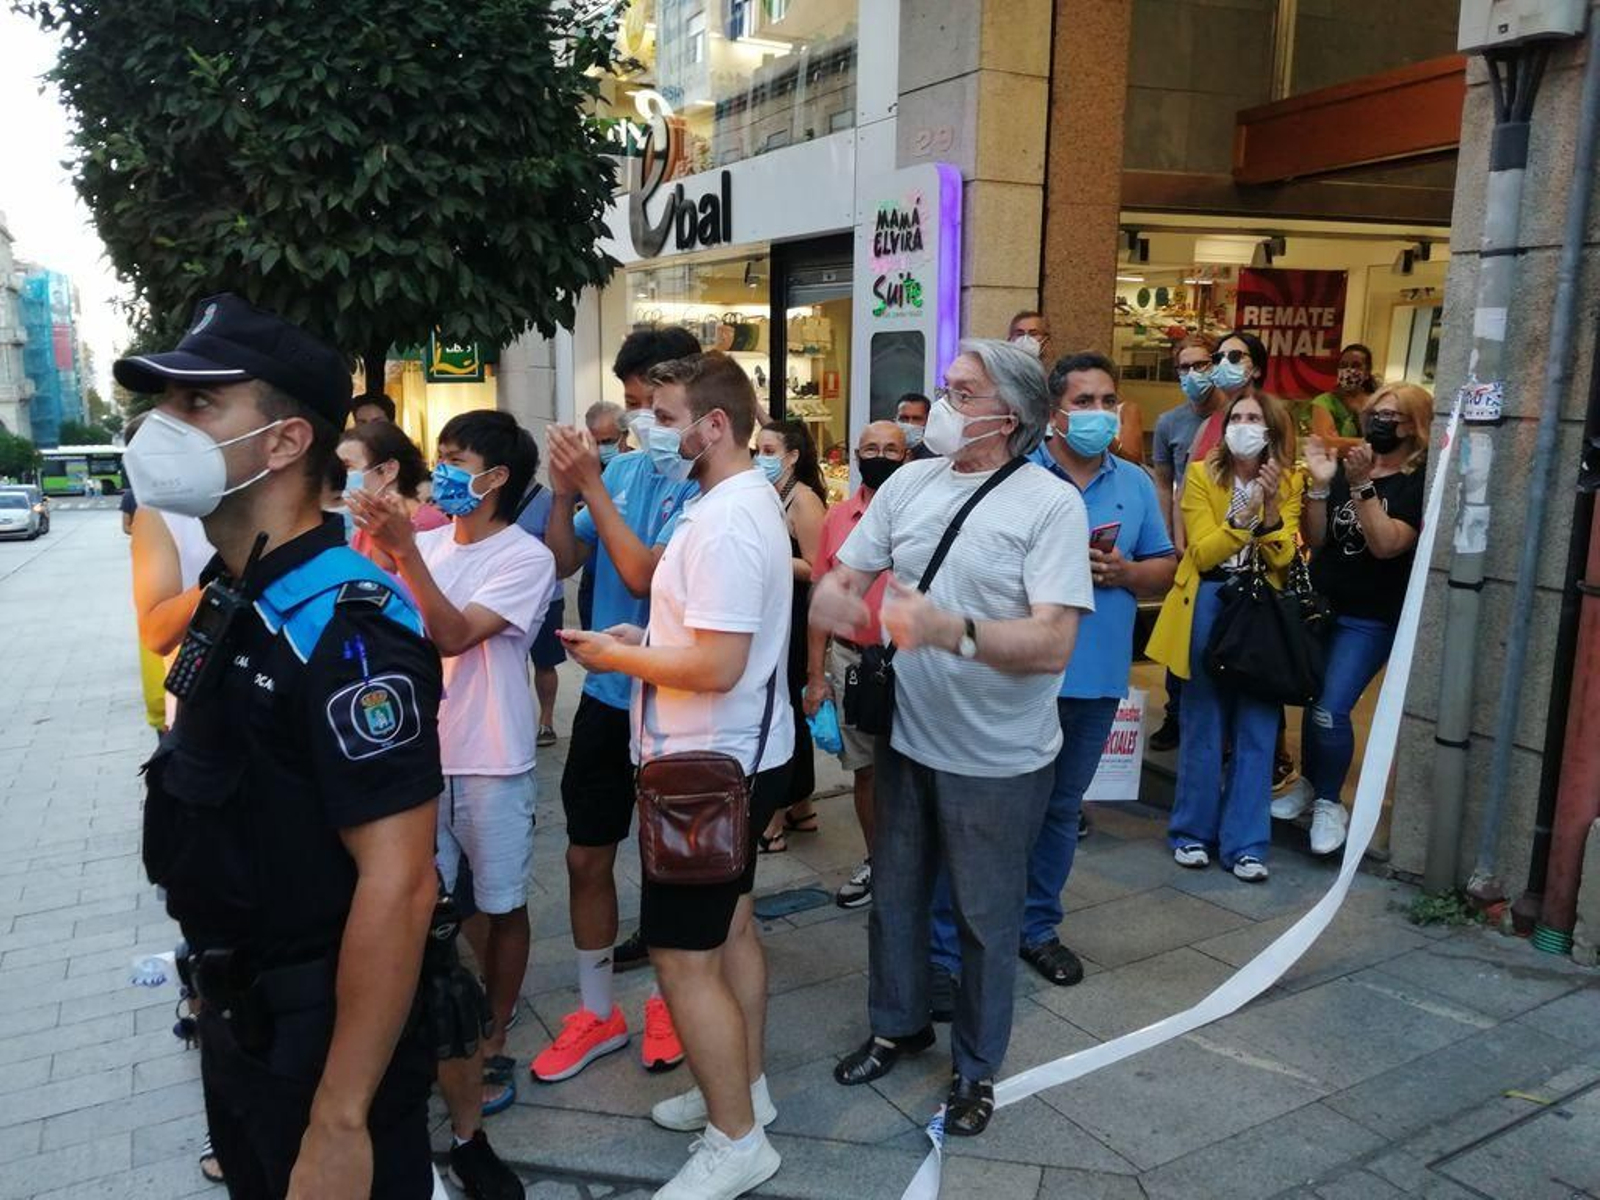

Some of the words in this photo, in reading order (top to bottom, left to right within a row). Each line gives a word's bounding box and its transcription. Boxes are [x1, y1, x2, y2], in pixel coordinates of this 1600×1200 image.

[912, 126, 954, 158] 29
[876, 197, 920, 231] MAMÁ
[873, 227, 923, 257] ELVIRA
[872, 271, 923, 317] Suite
[1243, 306, 1336, 327] REMATE
